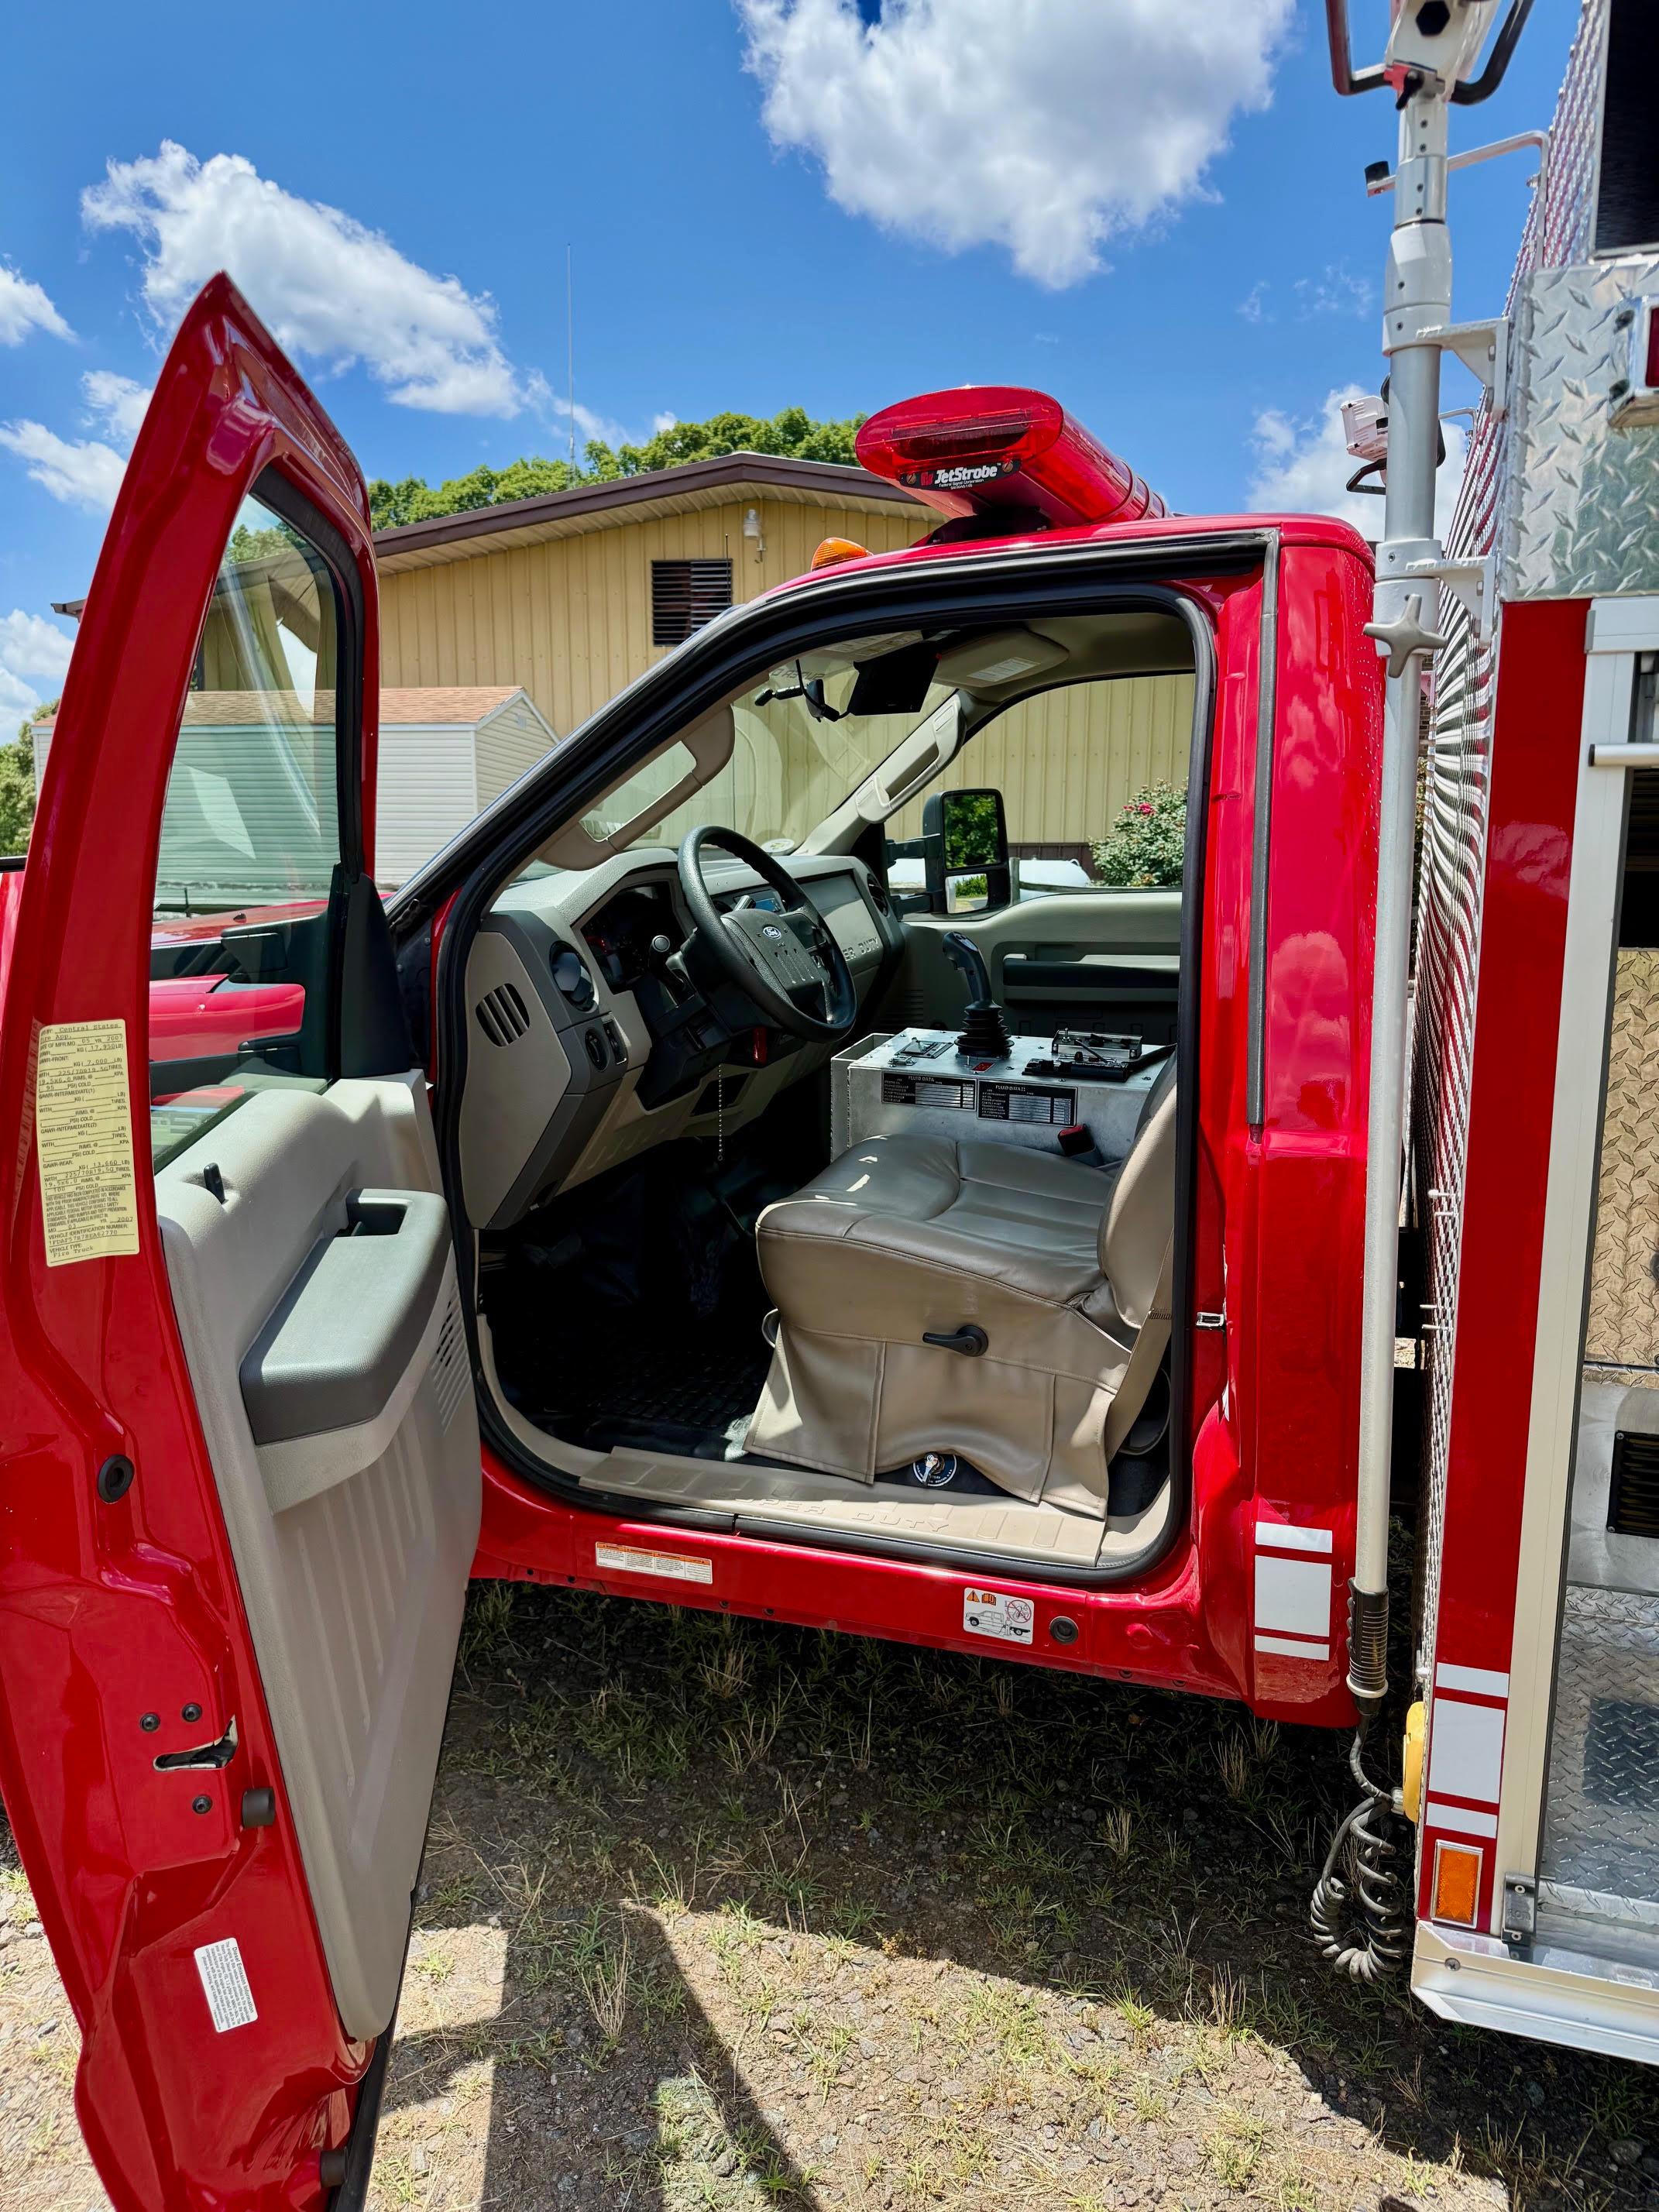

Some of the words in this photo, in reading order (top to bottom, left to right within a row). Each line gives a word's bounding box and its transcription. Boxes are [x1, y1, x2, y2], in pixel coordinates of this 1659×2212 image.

[934, 465, 997, 485] JetStrobe
[93, 1022, 118, 1030] States
[69, 1225, 105, 1235] IDENTIFICATION
[851, 1510, 950, 1532] DUTY
[232, 1946, 240, 1962] Diesel
[236, 1963, 246, 1984] Emission
[242, 1985, 254, 2013] Information
